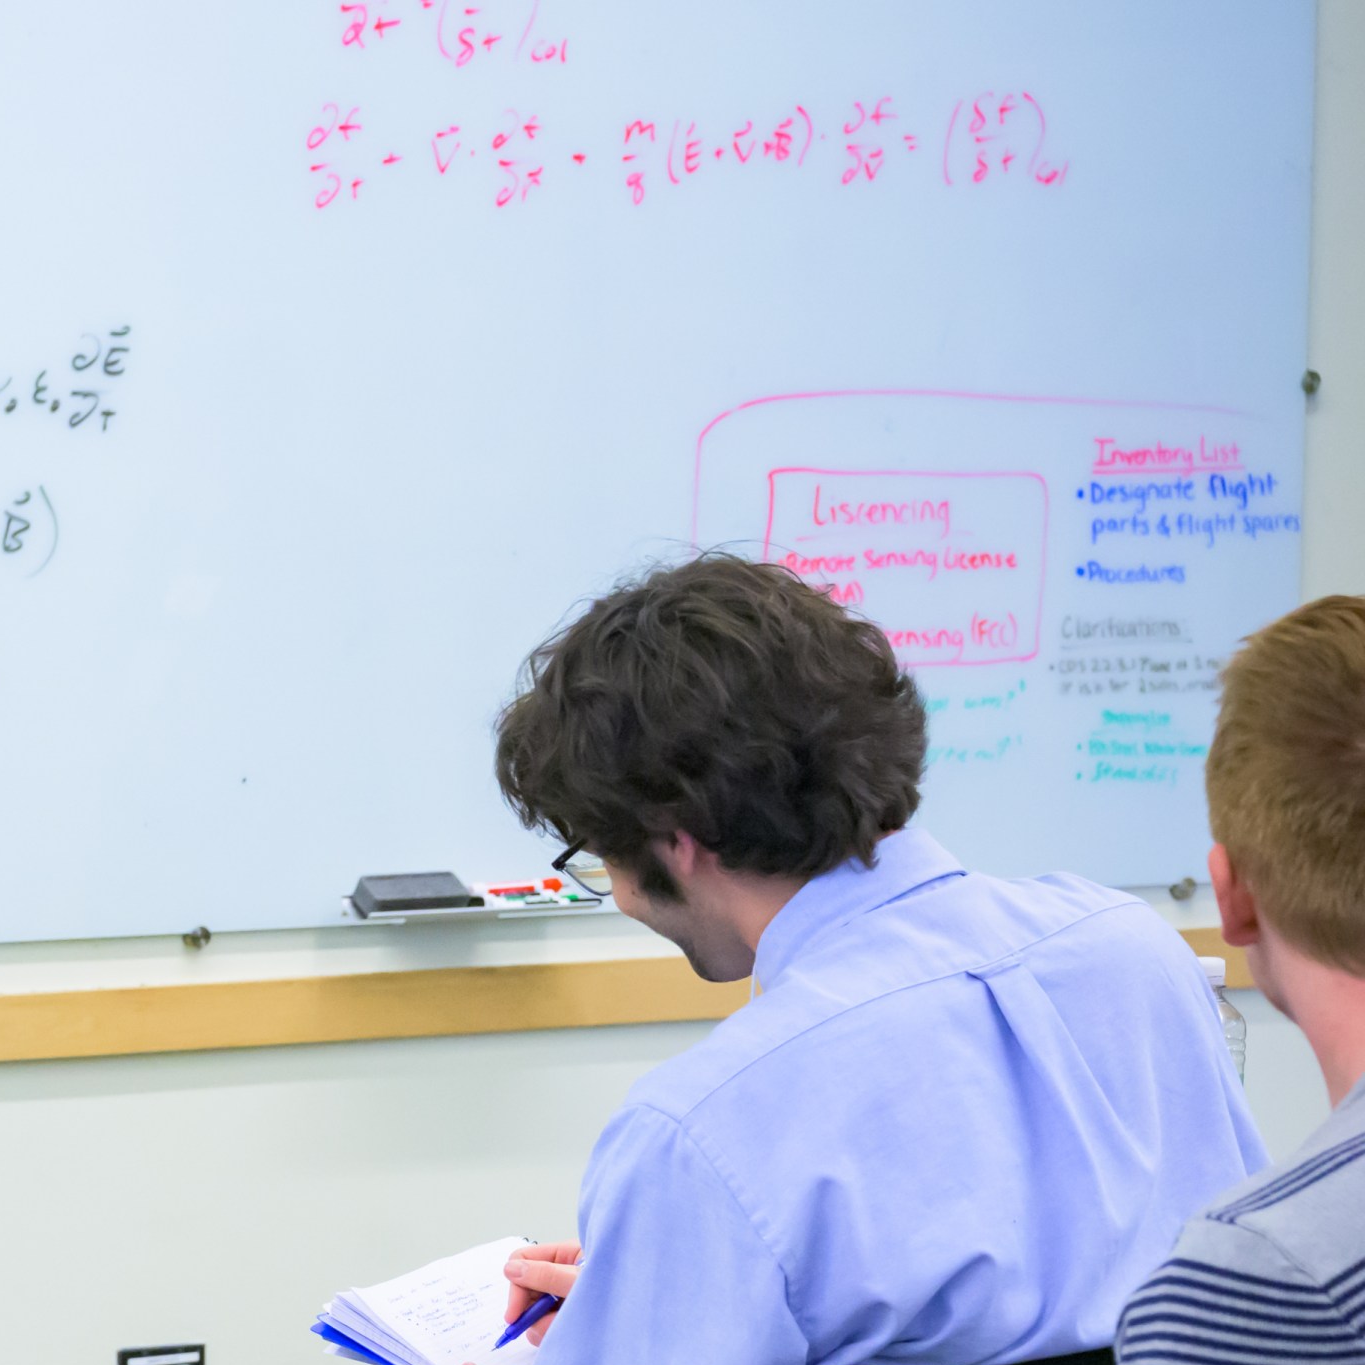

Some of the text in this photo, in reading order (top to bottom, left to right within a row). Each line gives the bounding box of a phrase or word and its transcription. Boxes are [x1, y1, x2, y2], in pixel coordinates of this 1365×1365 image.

[1091, 432, 1242, 479] Inventory List
[812, 483, 953, 540] Liscencing
[1089, 470, 1281, 515] Designate flight
[1091, 511, 1303, 549] parts & flight spares
[783, 545, 1020, 583] Remote Sensing License
[1086, 560, 1187, 585] Procedures
[970, 609, 1019, 652] (FCC)
